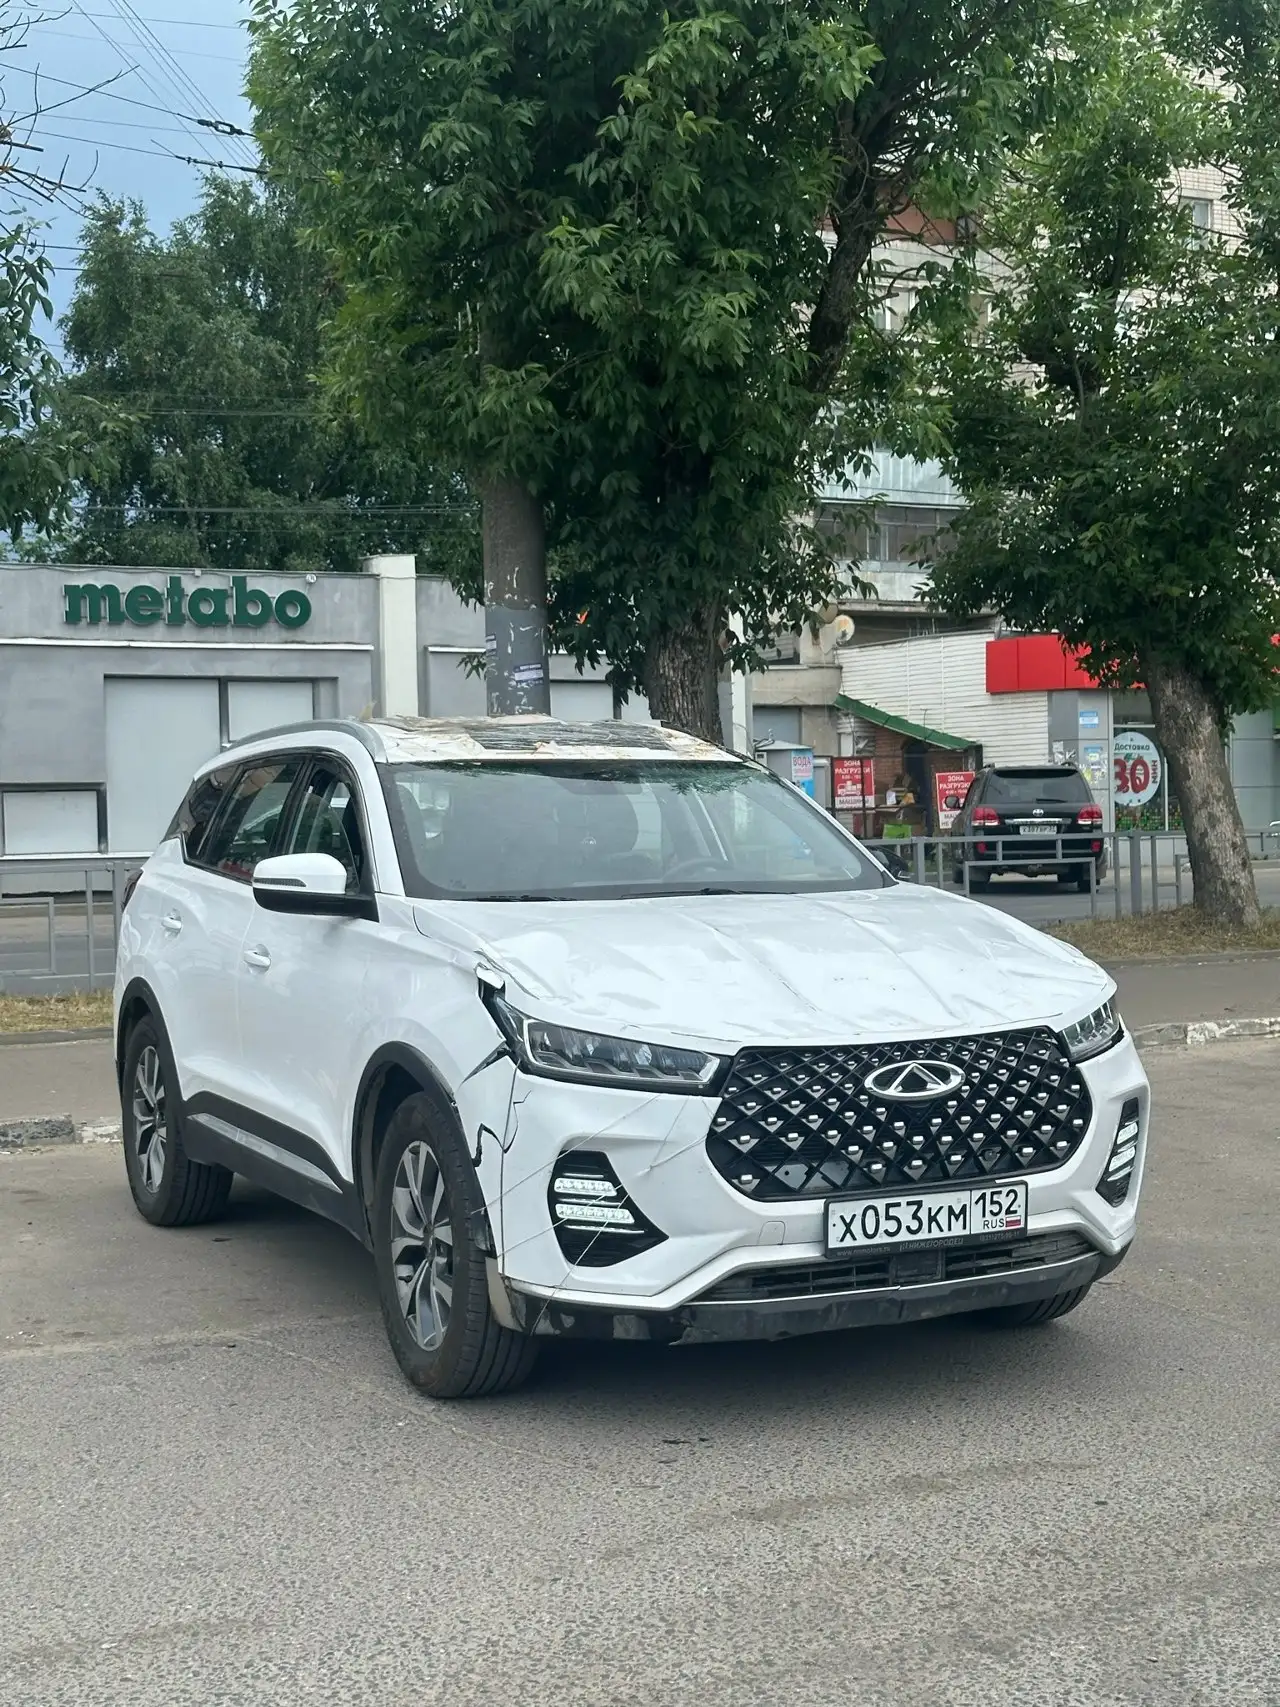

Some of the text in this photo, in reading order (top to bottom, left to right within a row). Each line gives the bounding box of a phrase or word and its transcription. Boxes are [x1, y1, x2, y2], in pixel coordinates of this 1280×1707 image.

[63, 575, 312, 629] metabo
[792, 756, 812, 768] ВОДА
[947, 774, 965, 782] ЗОНА
[1113, 757, 1150, 793] 30
[839, 1188, 1019, 1242] Х053КМ 152
[983, 1218, 1005, 1230] RUS
